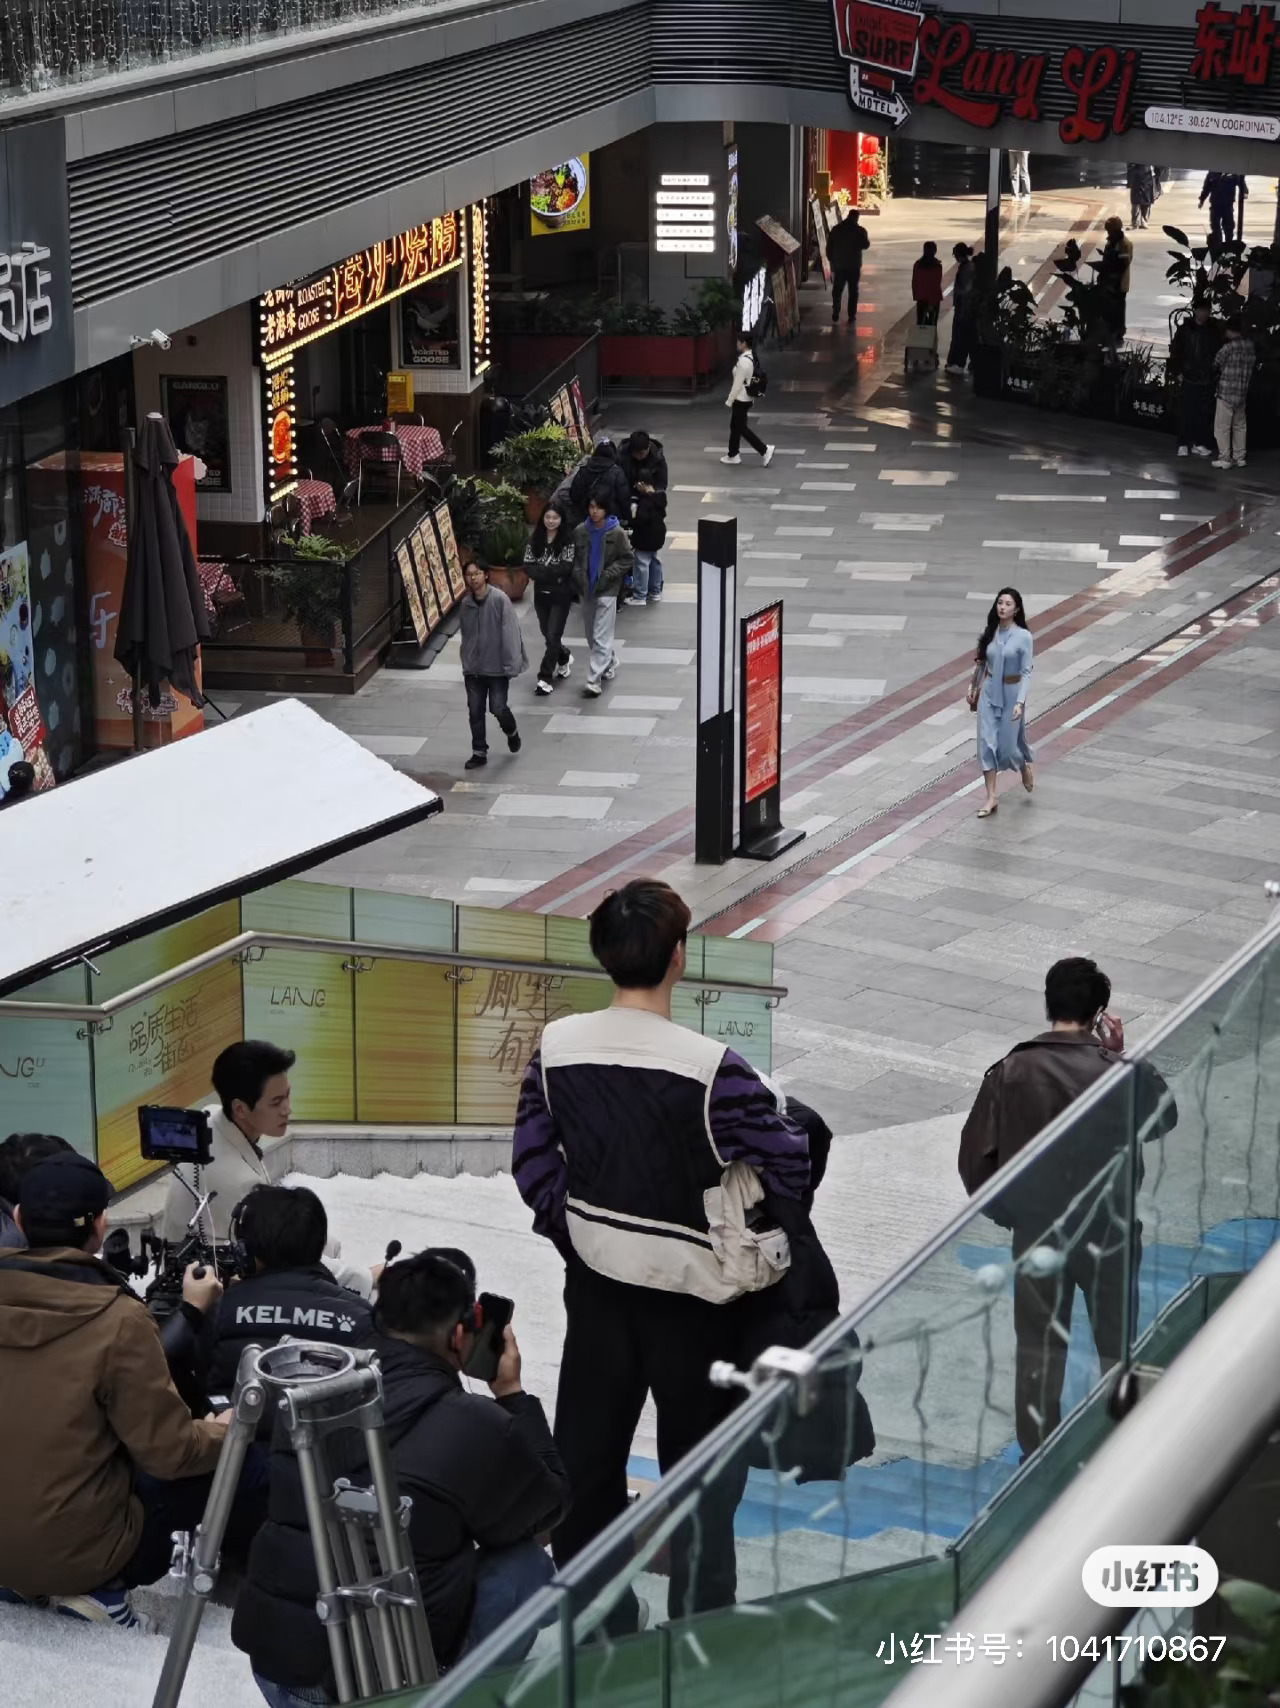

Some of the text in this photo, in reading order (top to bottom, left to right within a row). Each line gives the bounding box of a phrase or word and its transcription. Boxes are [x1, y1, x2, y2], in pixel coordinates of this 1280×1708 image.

[855, 29, 913, 66] SURF
[914, 16, 1136, 143] Lang Li
[859, 94, 892, 114] MOTEL
[1221, 118, 1276, 134] COORDINATE
[297, 280, 327, 307] ROASTED
[298, 306, 320, 331] GOOSE
[412, 356, 449, 364] GOOSE
[270, 986, 326, 1008] LANG
[718, 1020, 754, 1037] LANG
[236, 1305, 335, 1328] KELME
